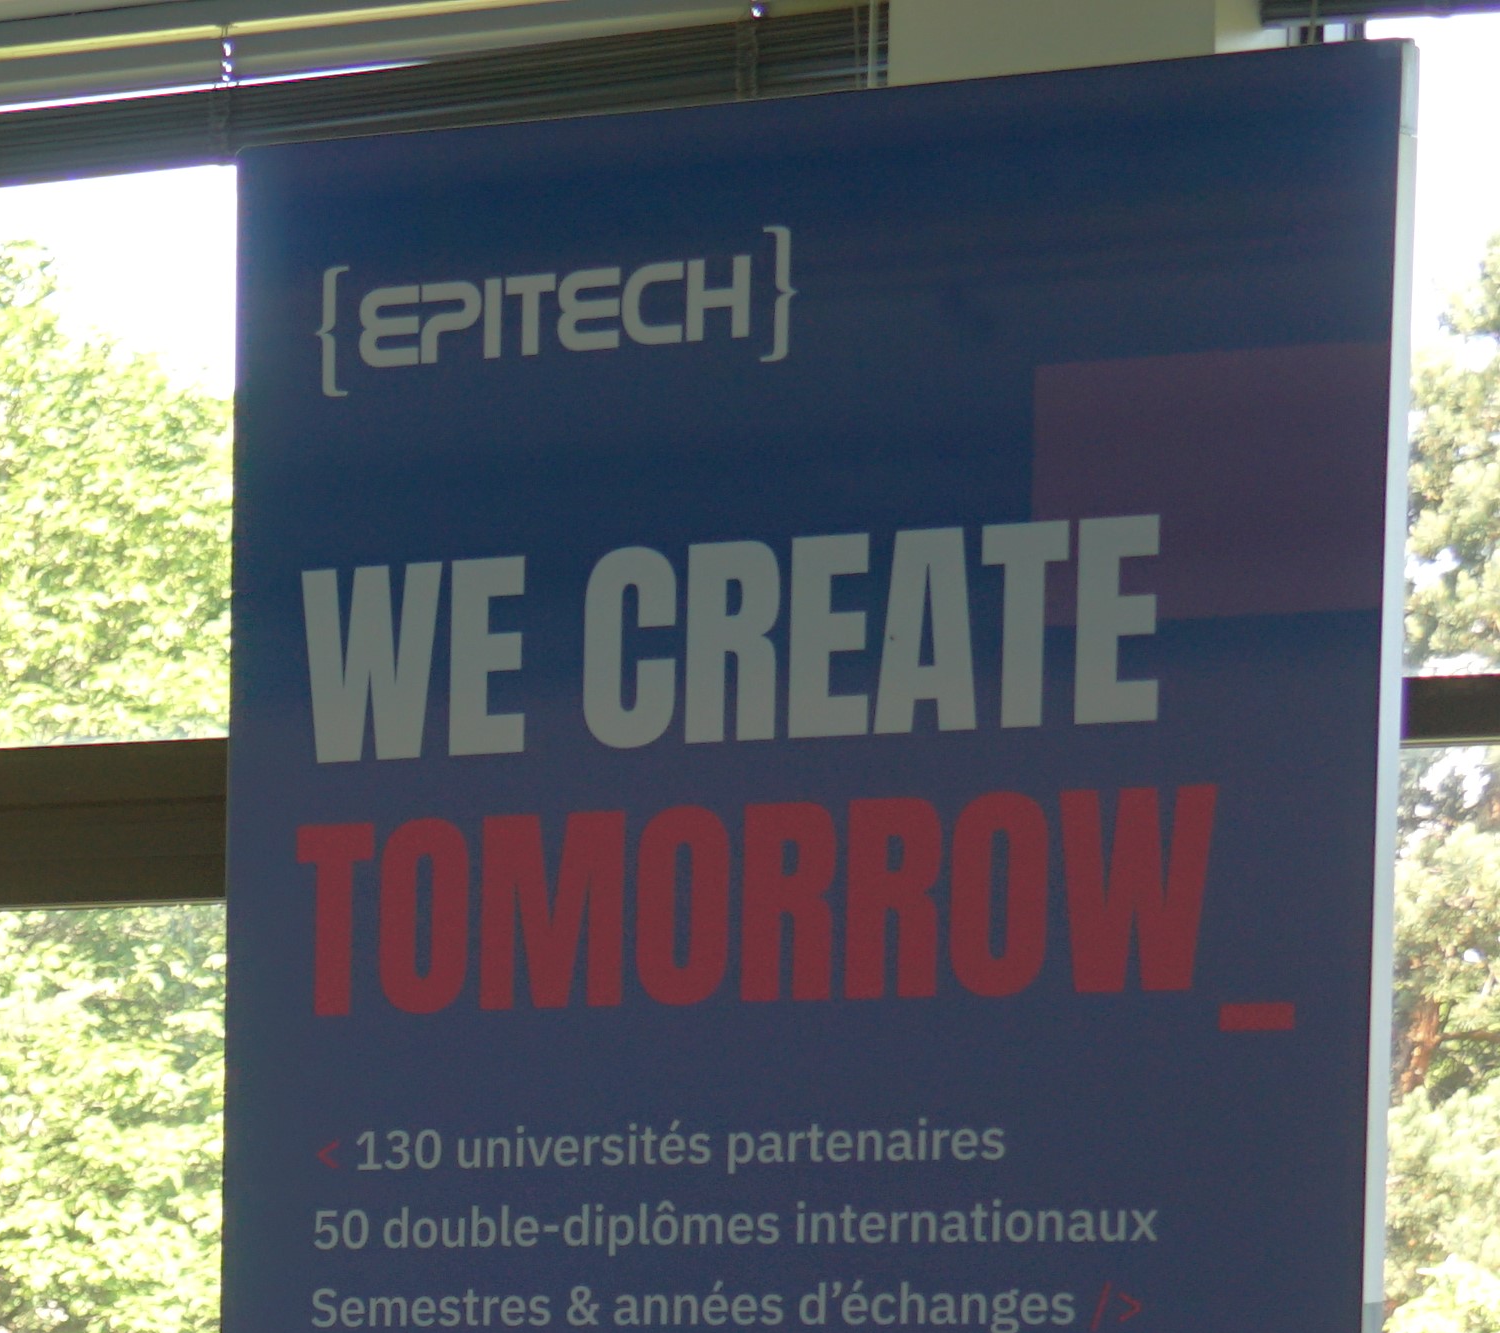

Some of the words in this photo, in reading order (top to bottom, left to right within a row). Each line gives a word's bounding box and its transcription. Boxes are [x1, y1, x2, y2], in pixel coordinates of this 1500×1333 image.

[302, 555, 525, 763] WE
[583, 513, 1160, 750] CREATE
[356, 1129, 442, 1171] 130
[456, 1120, 711, 1169] universités
[727, 1117, 1006, 1174] partenaires
[313, 1209, 369, 1250] 50
[383, 1201, 780, 1257] double-diplômes
[796, 1200, 1158, 1244] internationaux
[311, 1286, 551, 1328] Semestres
[566, 1286, 599, 1327] &
[614, 1280, 784, 1327] années
